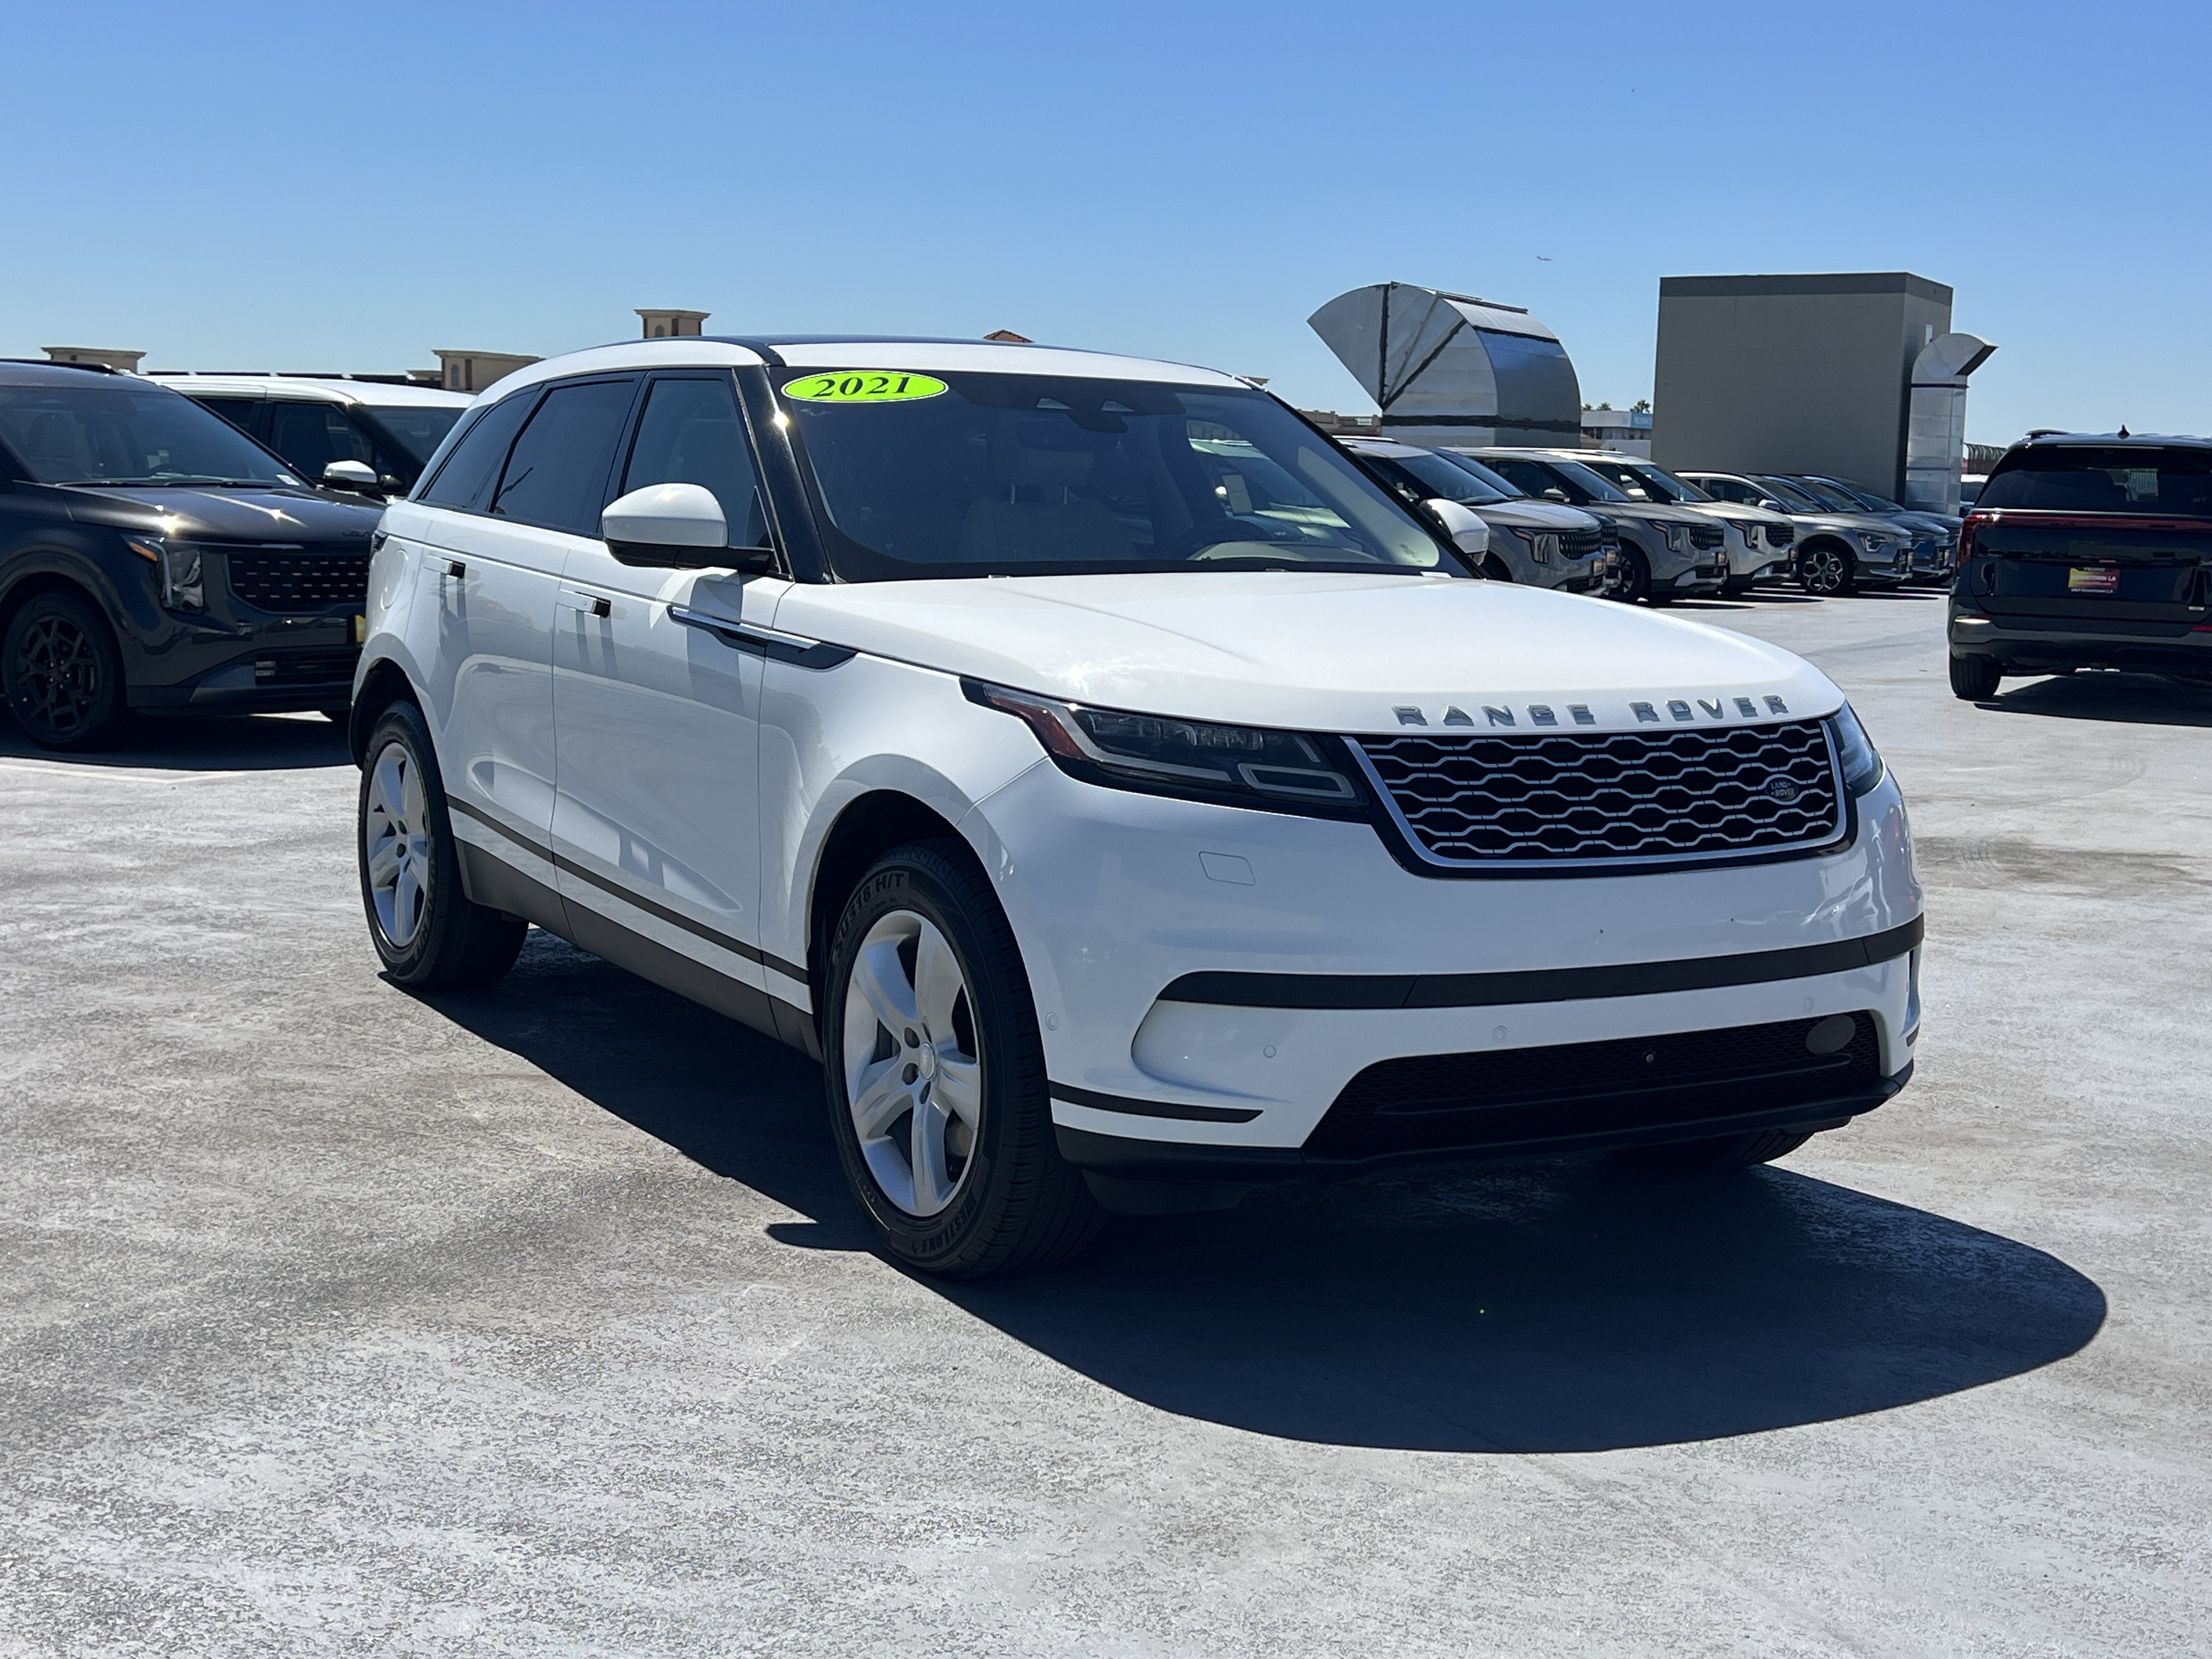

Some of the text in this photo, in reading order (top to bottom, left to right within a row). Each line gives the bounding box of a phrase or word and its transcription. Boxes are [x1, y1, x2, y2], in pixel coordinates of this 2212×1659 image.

[812, 377, 910, 397] 2021
[1391, 695, 1789, 726] RANGE ROVER
[876, 873, 904, 892] H/T
